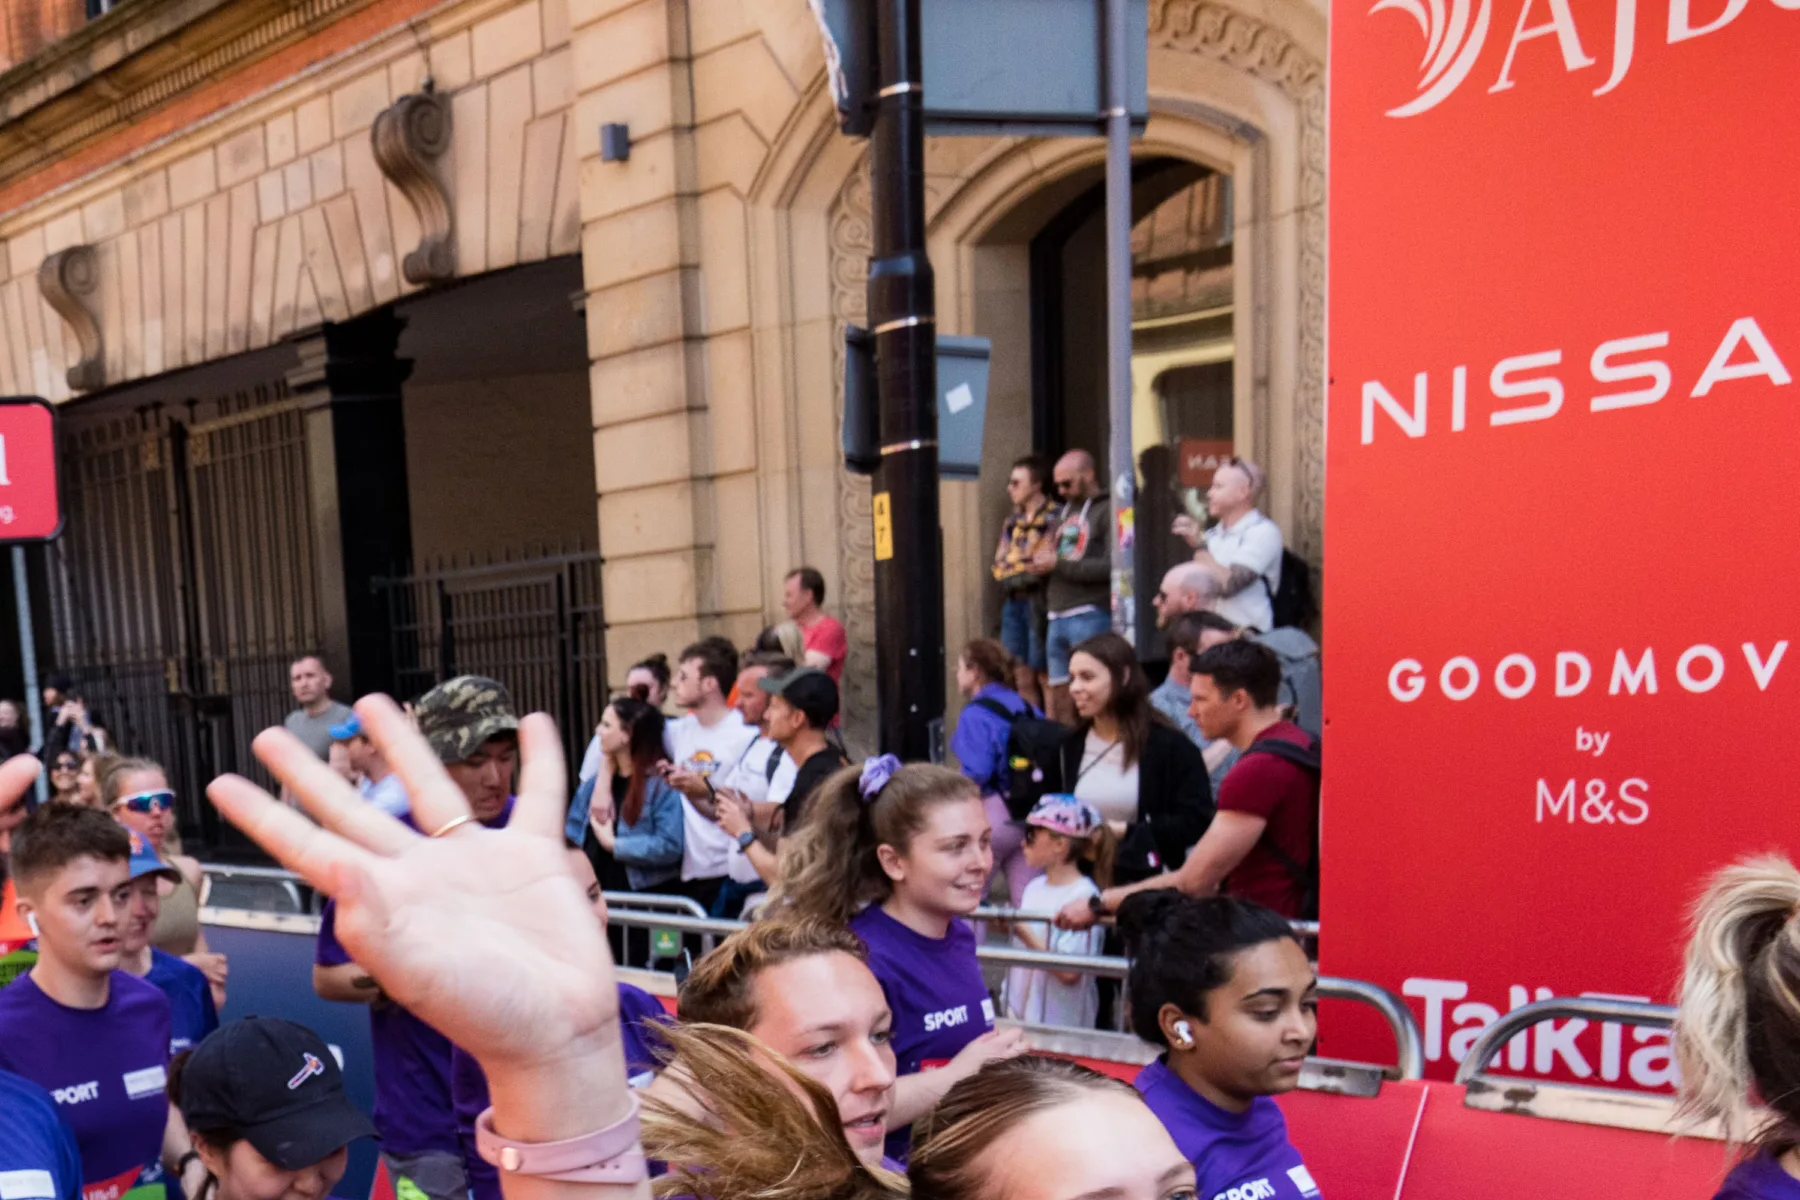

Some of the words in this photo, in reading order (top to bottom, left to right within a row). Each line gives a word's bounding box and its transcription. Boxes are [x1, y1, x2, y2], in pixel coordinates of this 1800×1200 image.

[1361, 317, 1792, 446] NISSA
[1388, 640, 1789, 702] GOODMOV
[1575, 726, 1611, 757] by
[1535, 777, 1649, 825] M&S
[924, 1005, 968, 1032] SPORT
[50, 1080, 99, 1105] PORT
